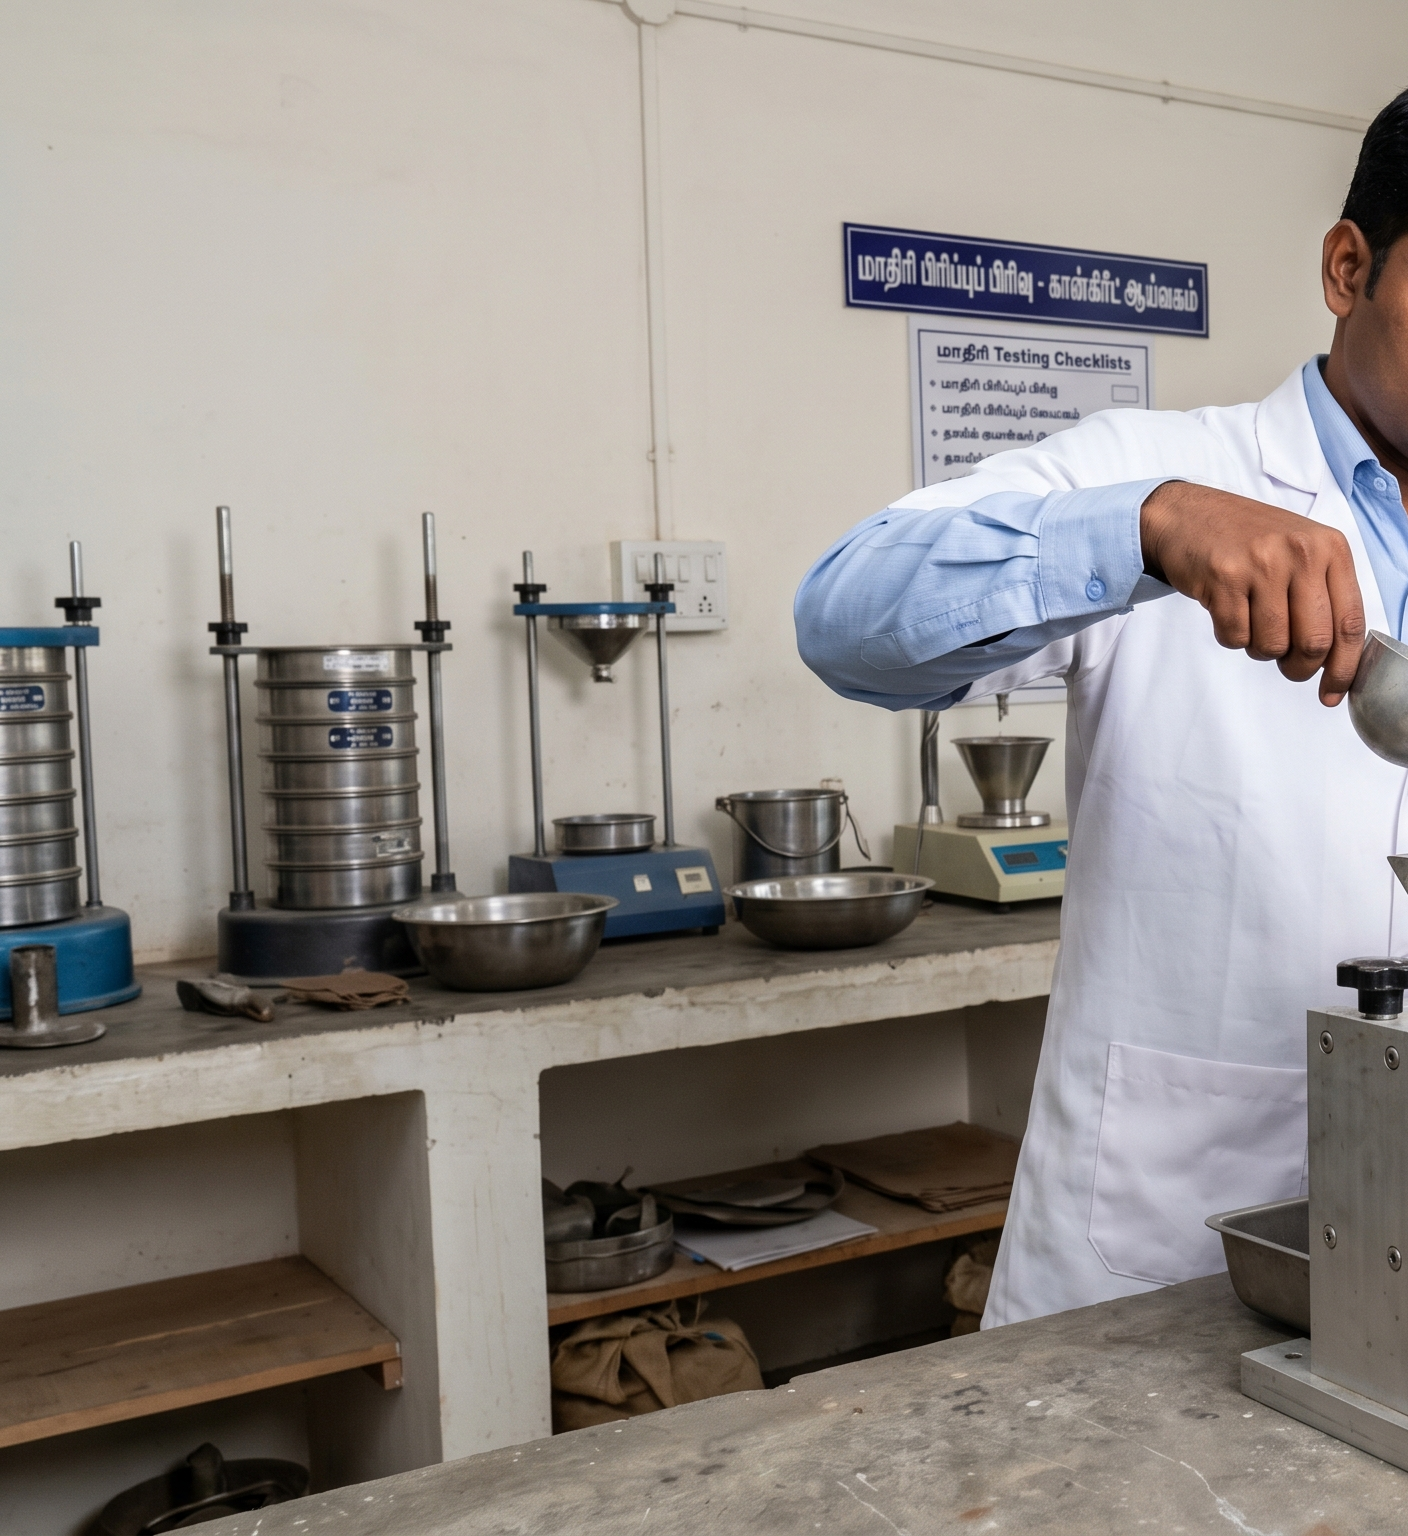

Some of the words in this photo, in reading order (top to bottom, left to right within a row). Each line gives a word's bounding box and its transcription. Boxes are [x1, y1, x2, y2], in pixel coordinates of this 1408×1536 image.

[858, 247, 916, 292] மாதிரி
[921, 251, 985, 299] பிரிப்புப்
[989, 259, 1034, 304] பிரிவு
[1124, 273, 1199, 313] ஆய்வகம்
[937, 343, 989, 363] மாதிரி
[994, 346, 1049, 369] Testing
[1054, 351, 1132, 371] Checklists
